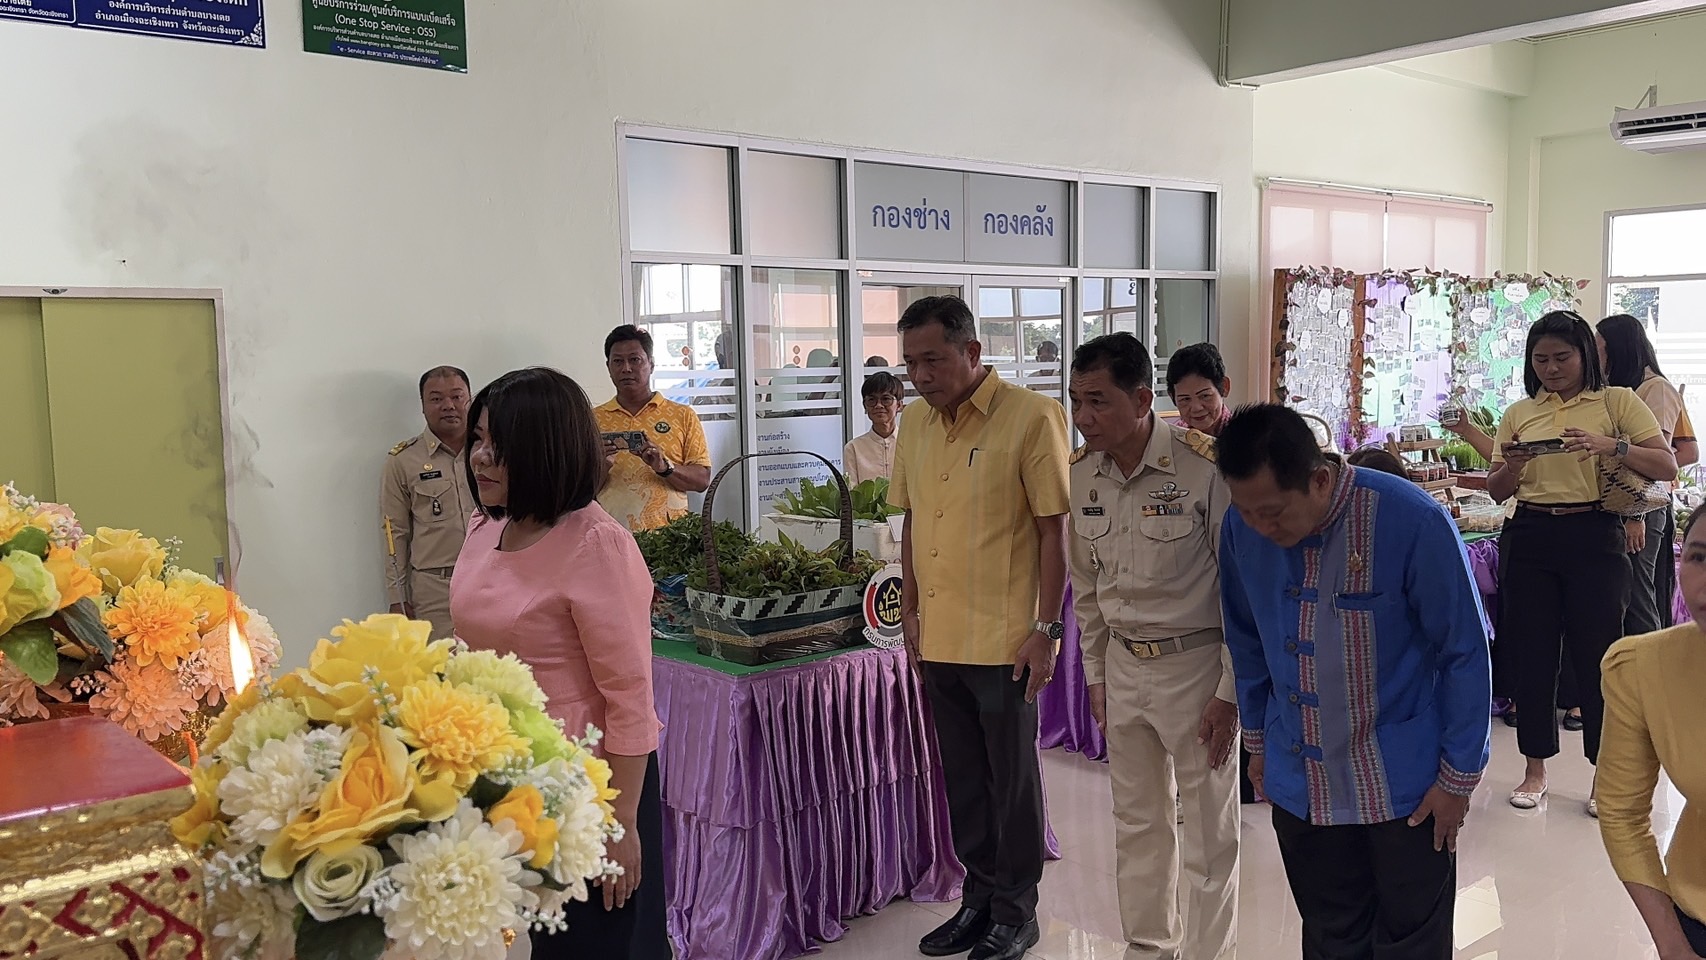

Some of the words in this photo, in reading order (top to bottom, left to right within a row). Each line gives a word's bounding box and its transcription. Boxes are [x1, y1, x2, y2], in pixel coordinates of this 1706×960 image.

[95, 10, 179, 29] อำเภอเมืองฉะเชิงเทรา
[182, 21, 245, 37] จังหวัดฉะเชิงเทรา
[335, 13, 357, 26] (One
[358, 17, 379, 31] Stop
[380, 21, 411, 34] Service
[417, 26, 437, 39] OSS)
[872, 198, 950, 231] กองช่าง
[983, 204, 1054, 237] กองคลัง
